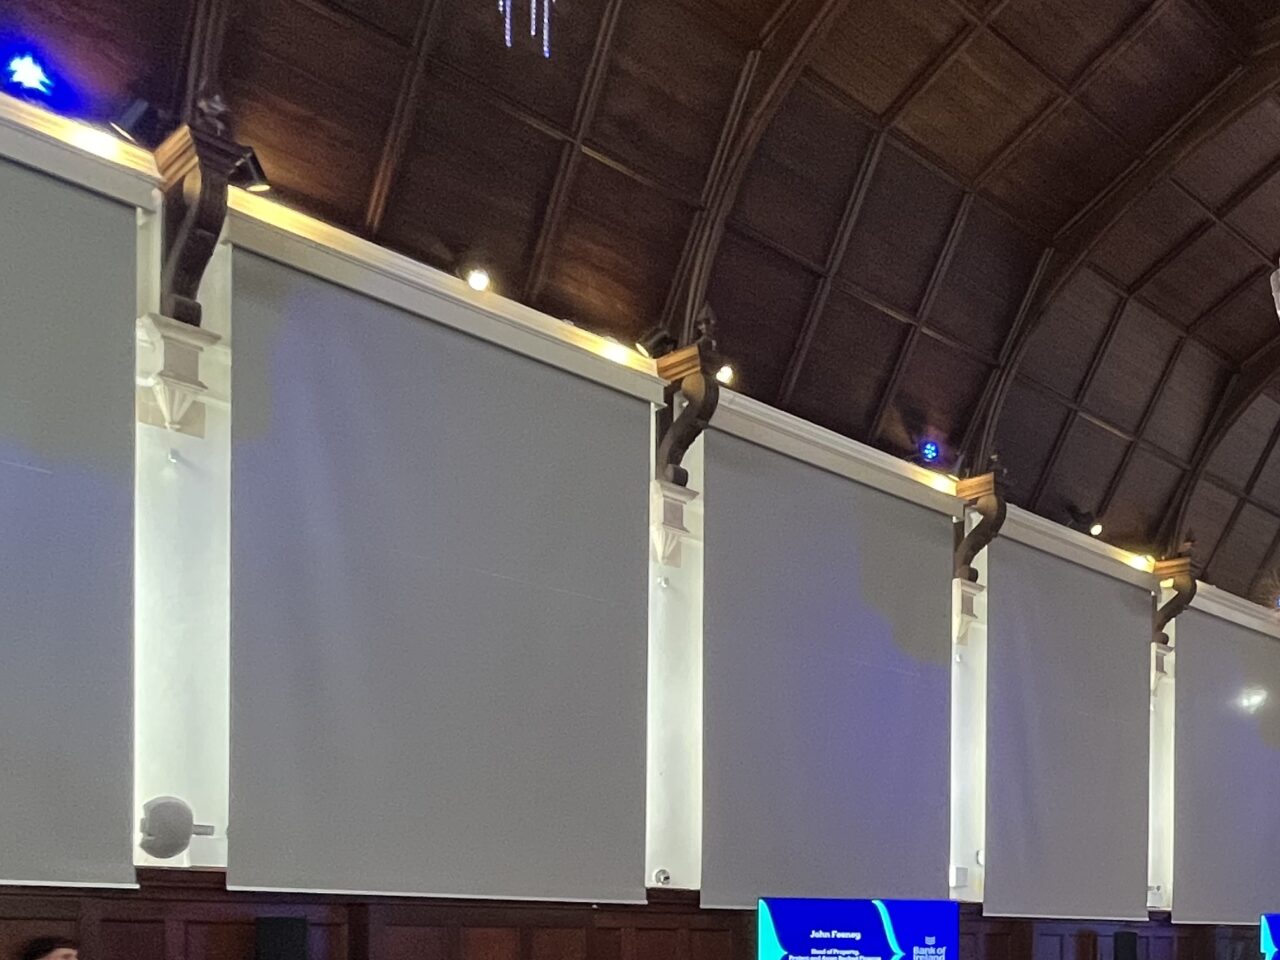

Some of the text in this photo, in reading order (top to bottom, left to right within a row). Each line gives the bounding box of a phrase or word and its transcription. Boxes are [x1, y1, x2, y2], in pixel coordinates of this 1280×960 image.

[810, 930, 830, 938] John
[913, 946, 947, 954] Bank of
